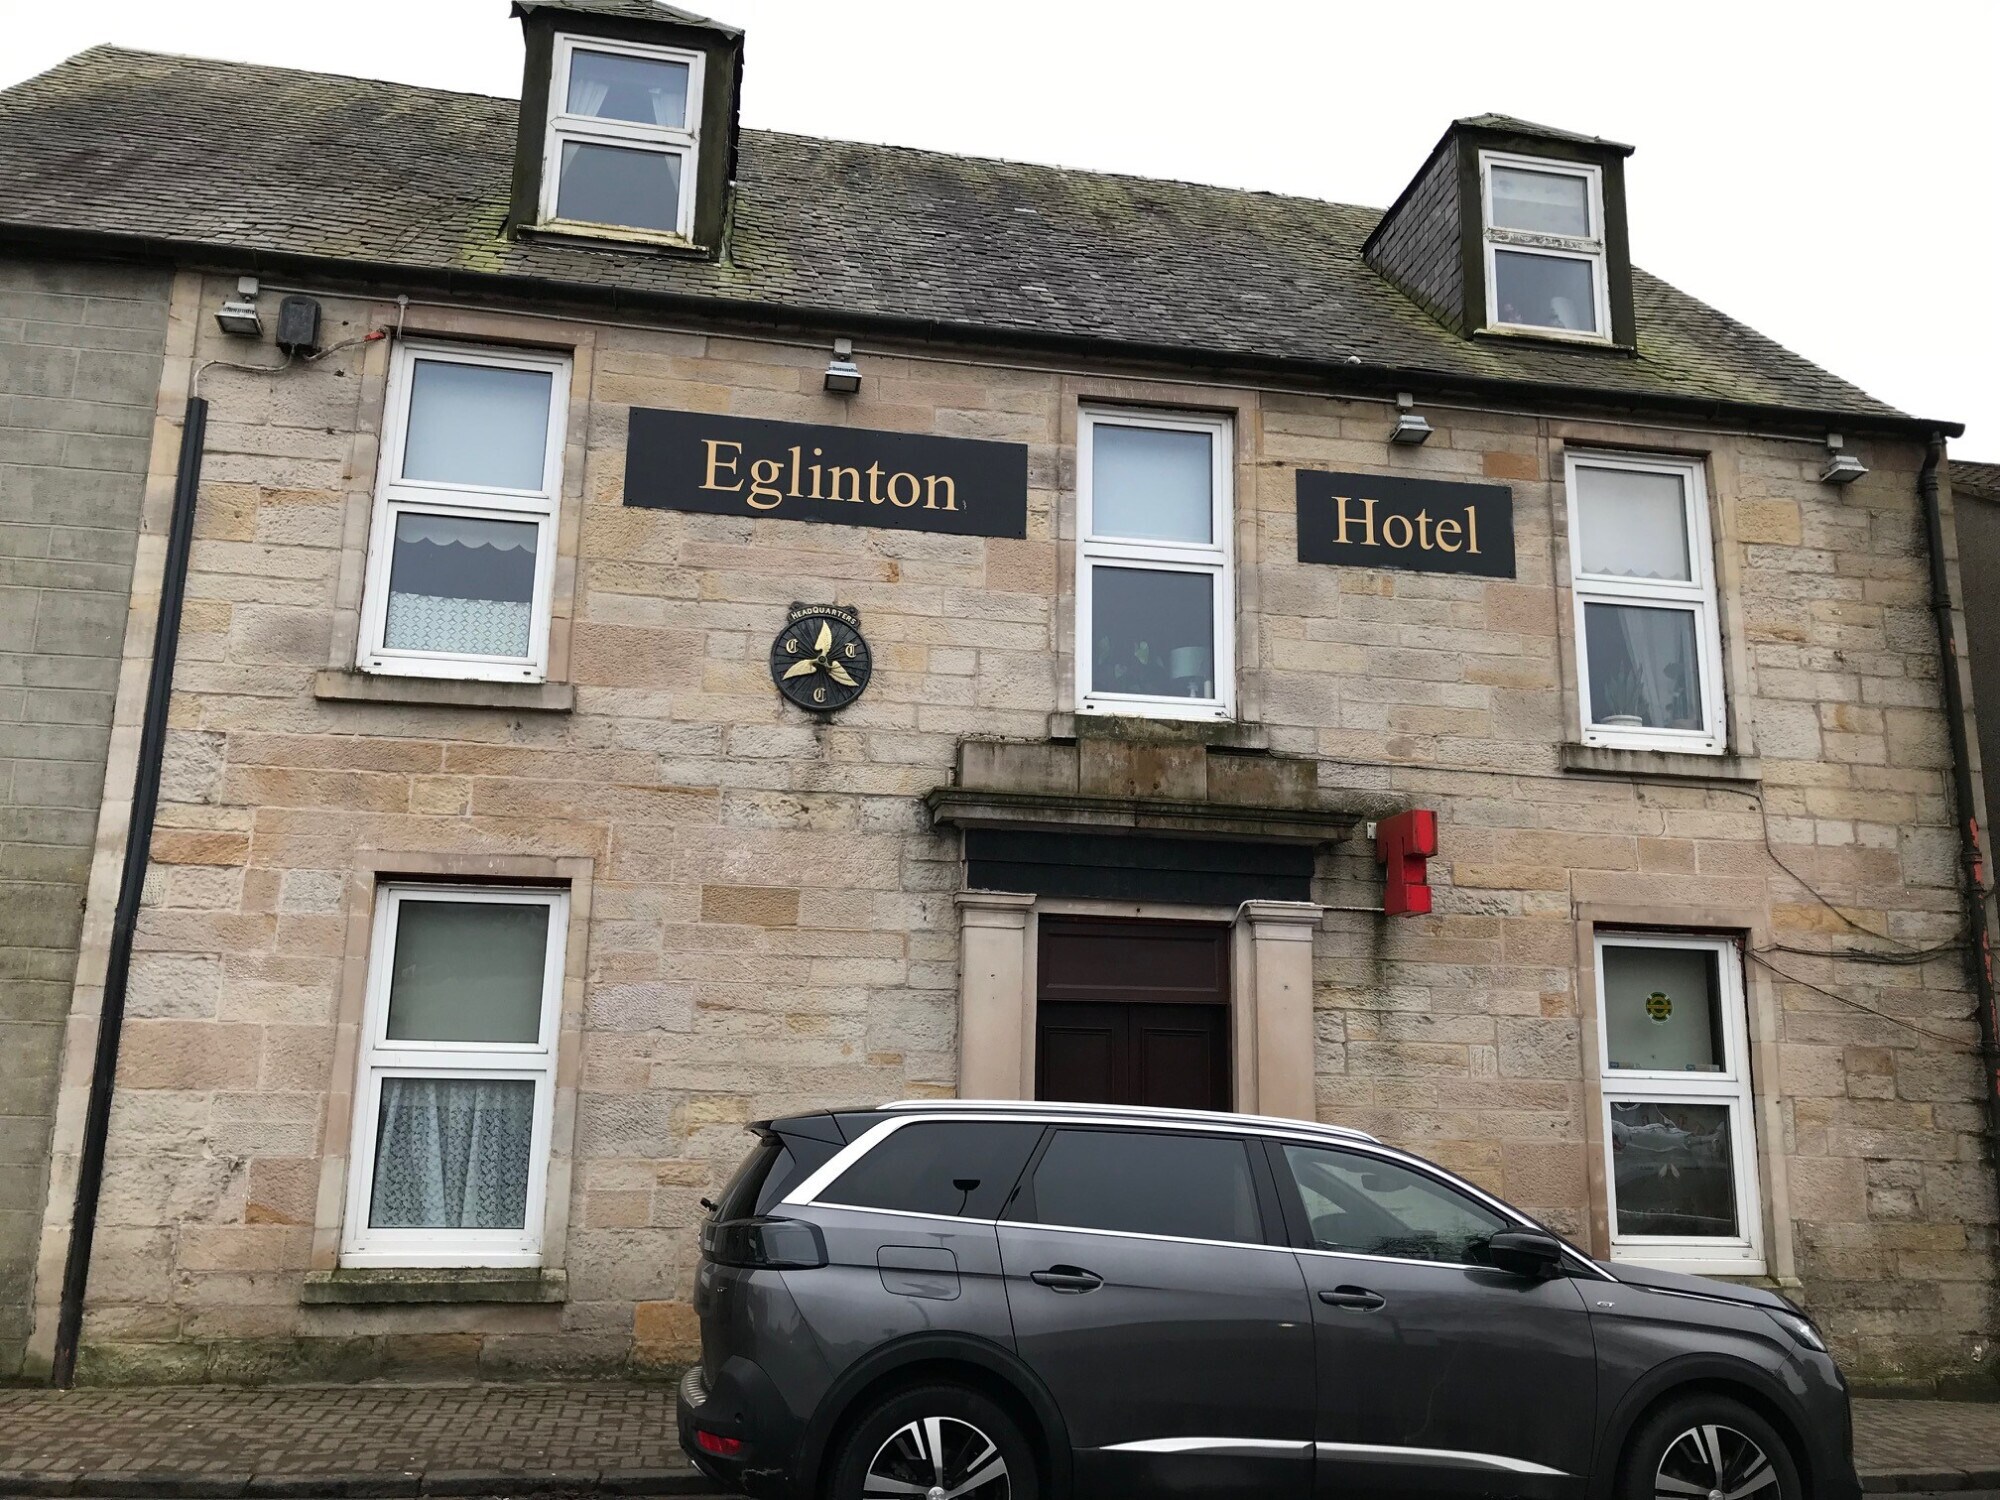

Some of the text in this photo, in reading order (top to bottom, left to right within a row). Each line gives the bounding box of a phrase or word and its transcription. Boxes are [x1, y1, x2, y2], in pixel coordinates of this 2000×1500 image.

[698, 438, 960, 511] Eglinton
[1331, 496, 1482, 554] Hotel
[791, 606, 857, 625] HEADQUARTERS
